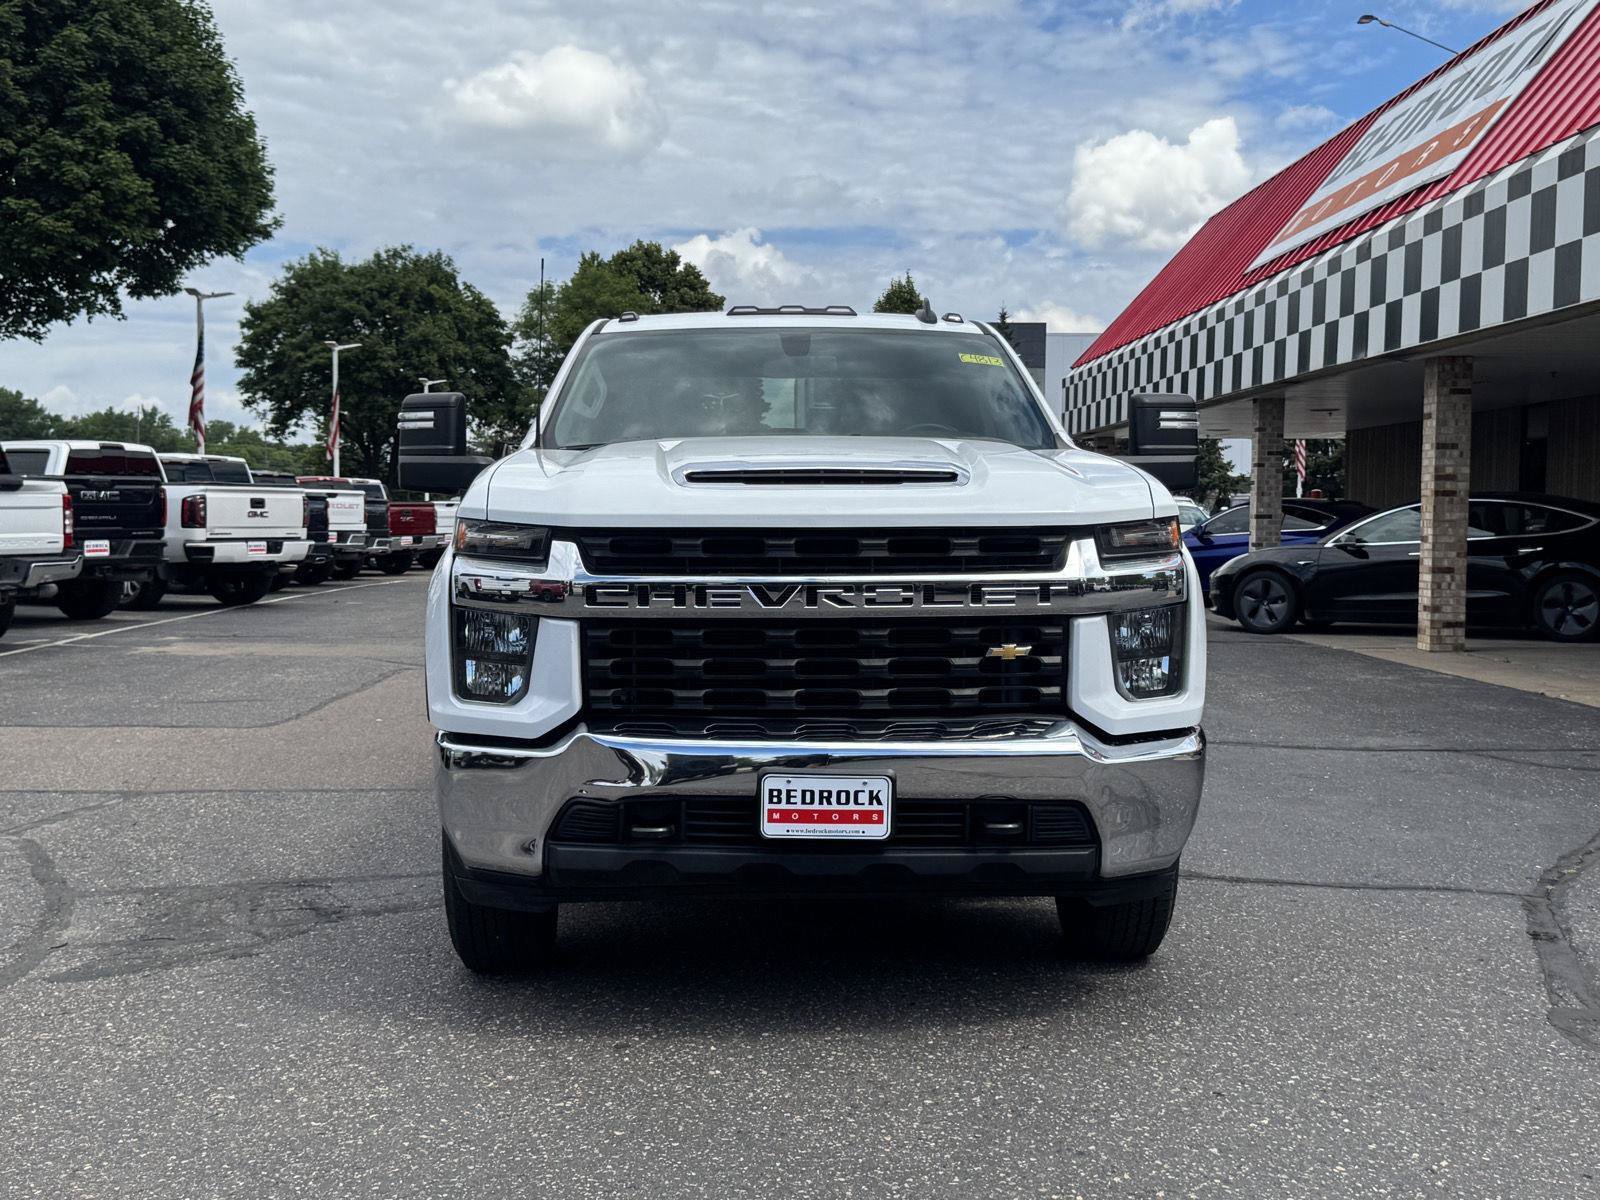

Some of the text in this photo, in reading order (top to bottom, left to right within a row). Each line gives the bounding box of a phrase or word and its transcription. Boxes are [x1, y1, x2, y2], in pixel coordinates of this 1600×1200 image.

[1282, 117, 1479, 236] MOTORS
[584, 582, 1069, 609] CHEVROLET
[768, 788, 884, 806] BEDROCK
[772, 812, 880, 821] MOTORS
